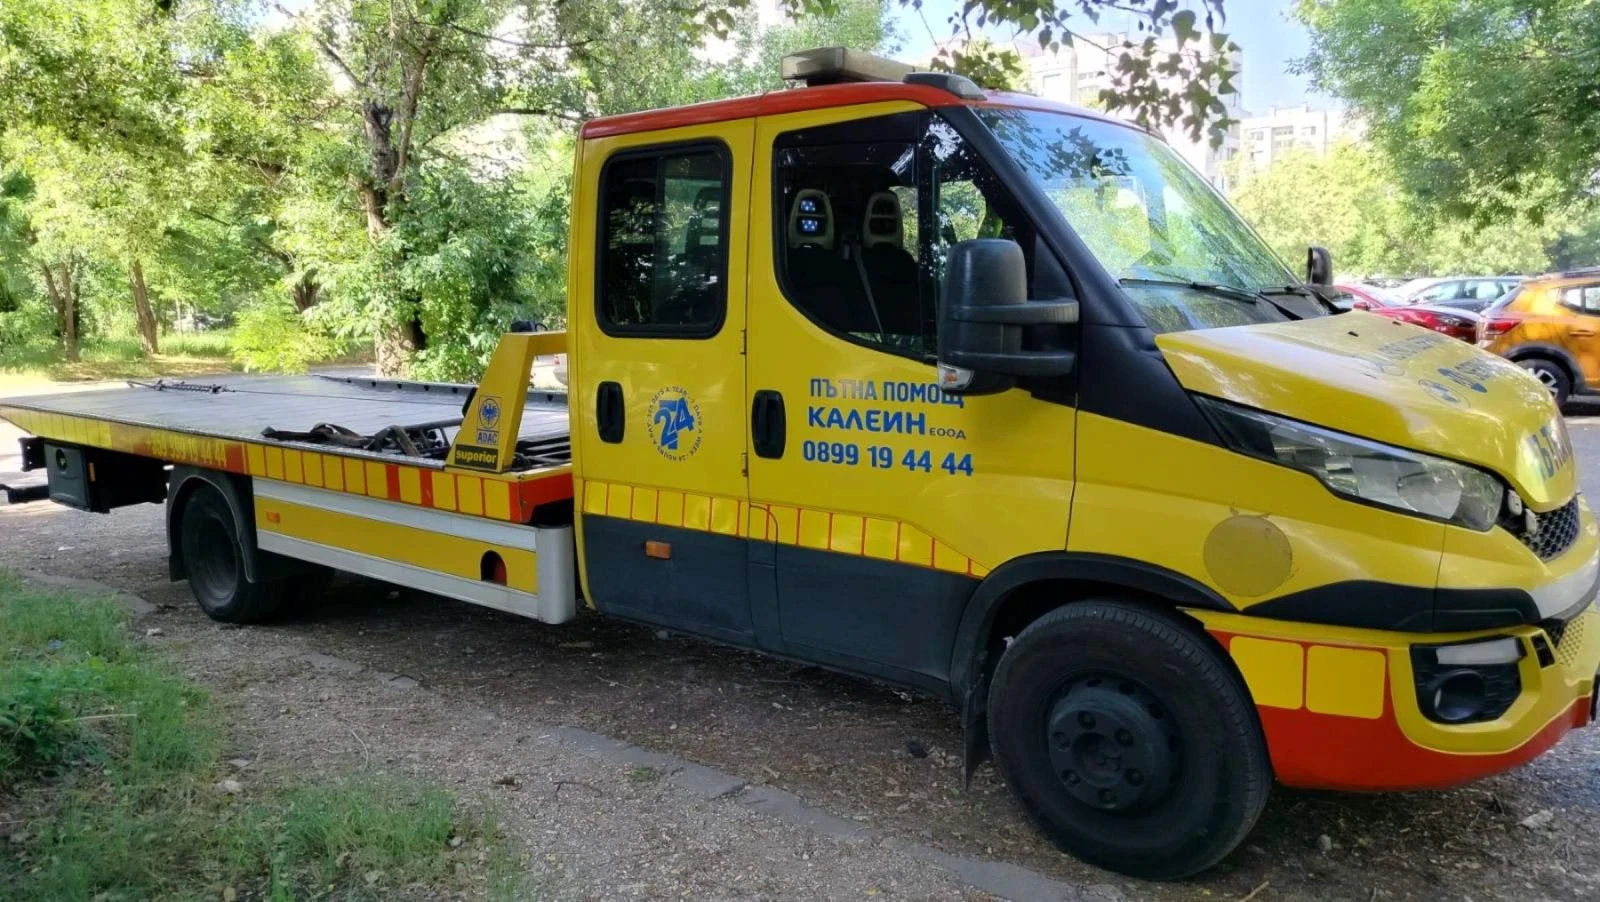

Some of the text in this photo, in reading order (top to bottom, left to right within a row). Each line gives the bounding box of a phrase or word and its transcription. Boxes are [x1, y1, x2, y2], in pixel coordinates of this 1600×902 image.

[810, 378, 878, 401] ПЪТНА
[808, 406, 966, 440] КАЛЕИН ЕООД
[477, 431, 498, 444] ADAC
[455, 450, 497, 463] superior
[803, 440, 974, 477] 0899 19 44 44
